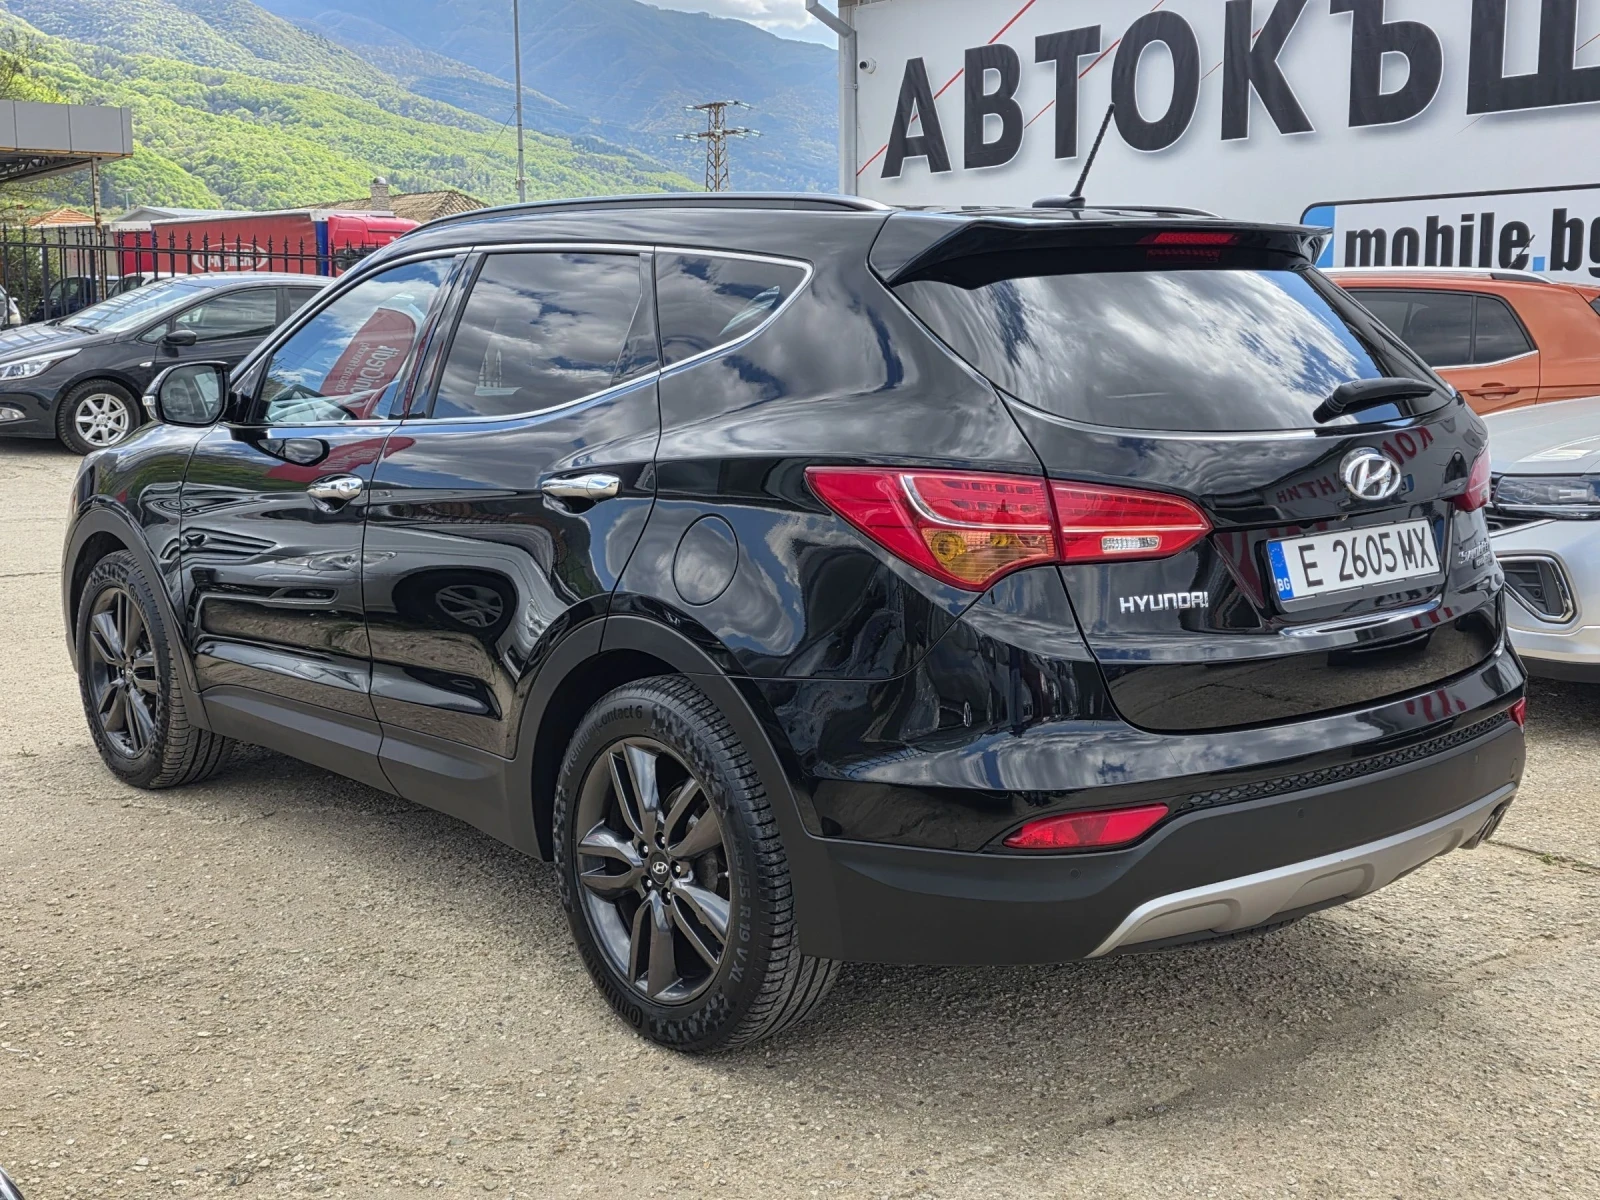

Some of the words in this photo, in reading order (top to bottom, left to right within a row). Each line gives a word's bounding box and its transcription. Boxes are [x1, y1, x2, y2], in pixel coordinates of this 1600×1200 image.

[1298, 544, 1324, 588] E
[1332, 532, 1398, 582] 2605
[1277, 577, 1291, 592] BG
[1119, 591, 1209, 614] HYUNDAI
